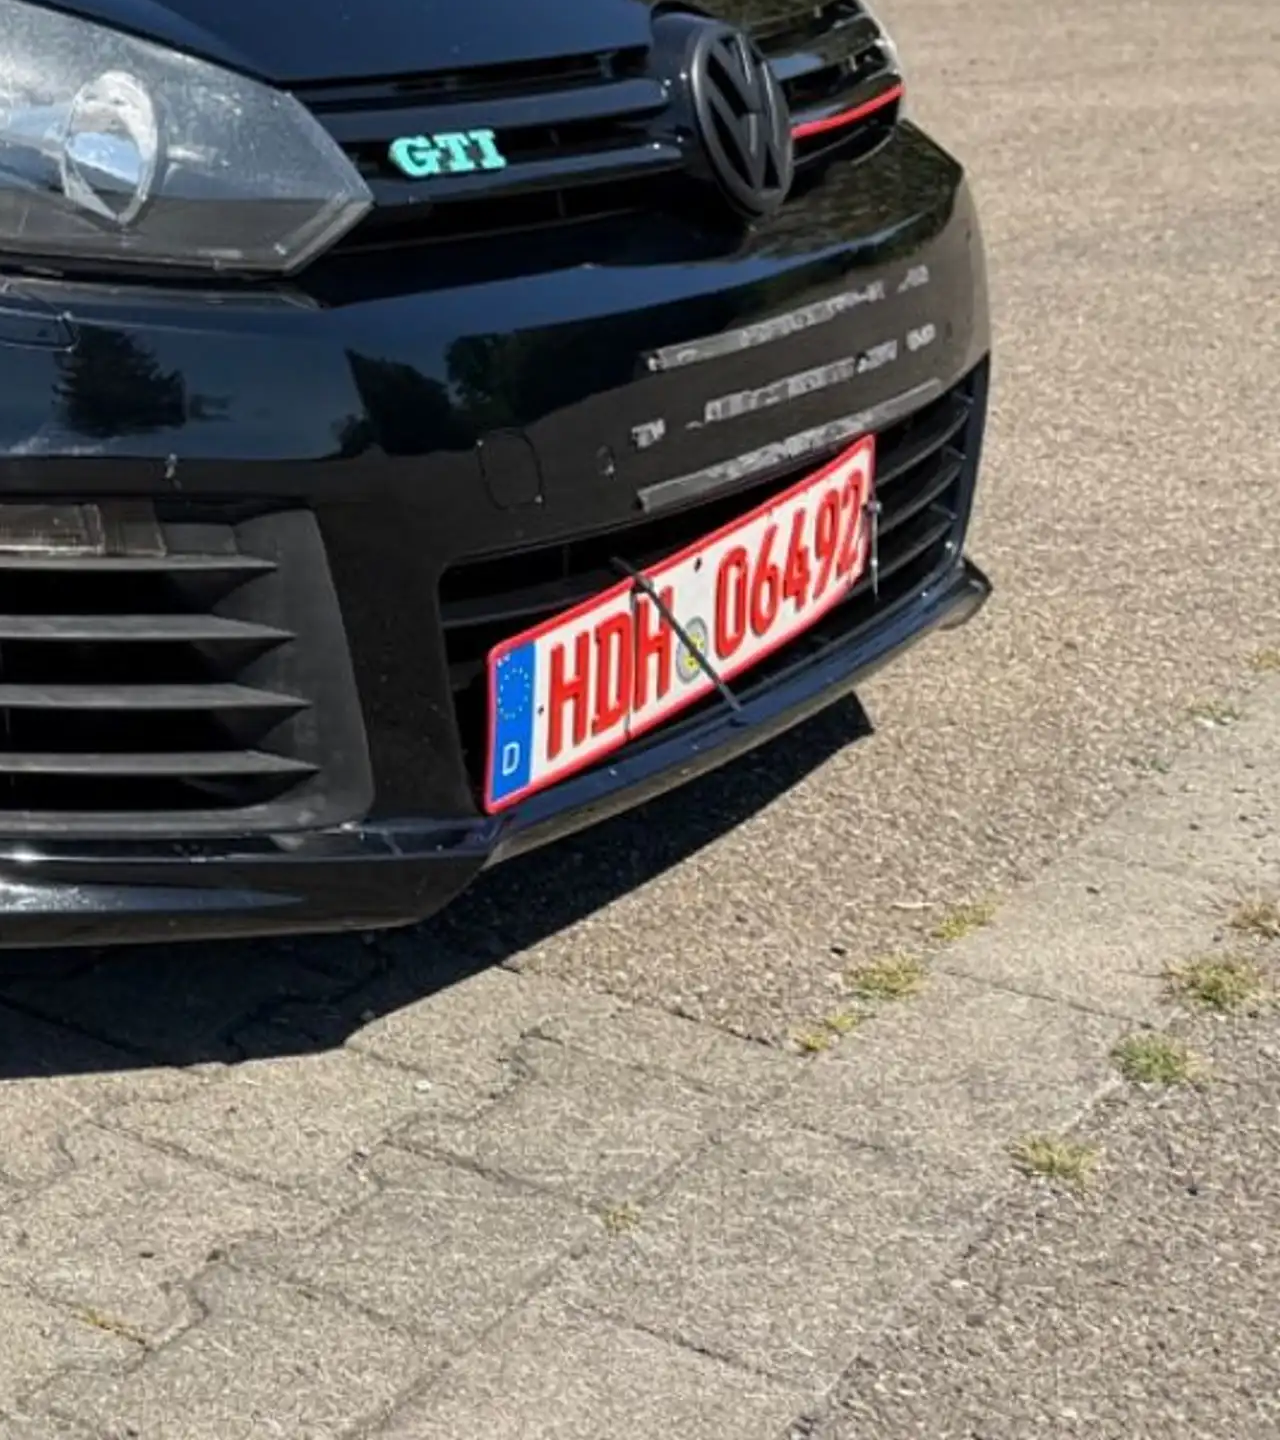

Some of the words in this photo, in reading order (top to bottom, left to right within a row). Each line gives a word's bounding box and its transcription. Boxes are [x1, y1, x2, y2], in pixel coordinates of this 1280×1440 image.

[390, 129, 506, 176] GTI
[546, 585, 676, 760] HDH
[714, 469, 864, 659] 06492
[502, 741, 521, 776] D
